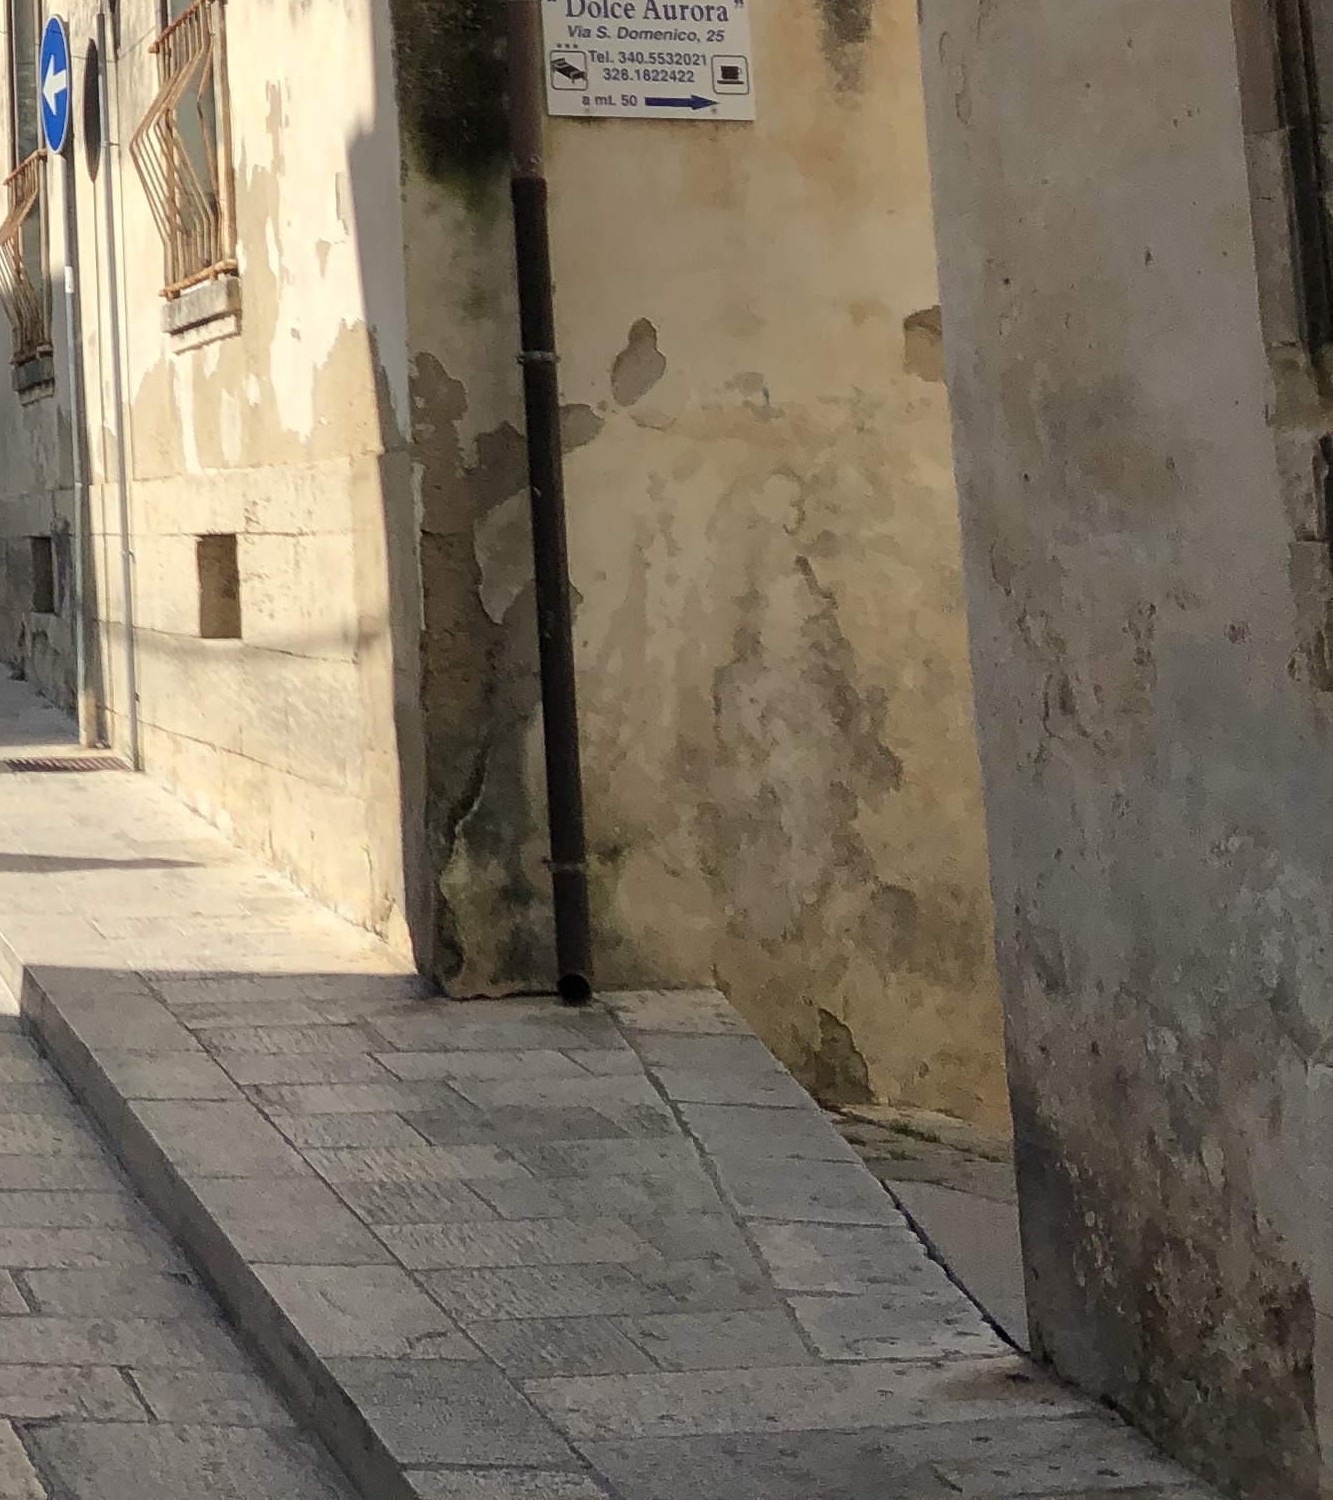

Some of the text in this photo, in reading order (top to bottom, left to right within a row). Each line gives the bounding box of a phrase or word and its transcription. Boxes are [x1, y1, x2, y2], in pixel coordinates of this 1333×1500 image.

[567, 25, 725, 43] Via S. Domenico, 25
[588, 50, 707, 67] Tel. 340.5532021
[582, 96, 590, 106] a
[621, 95, 638, 107] 50
